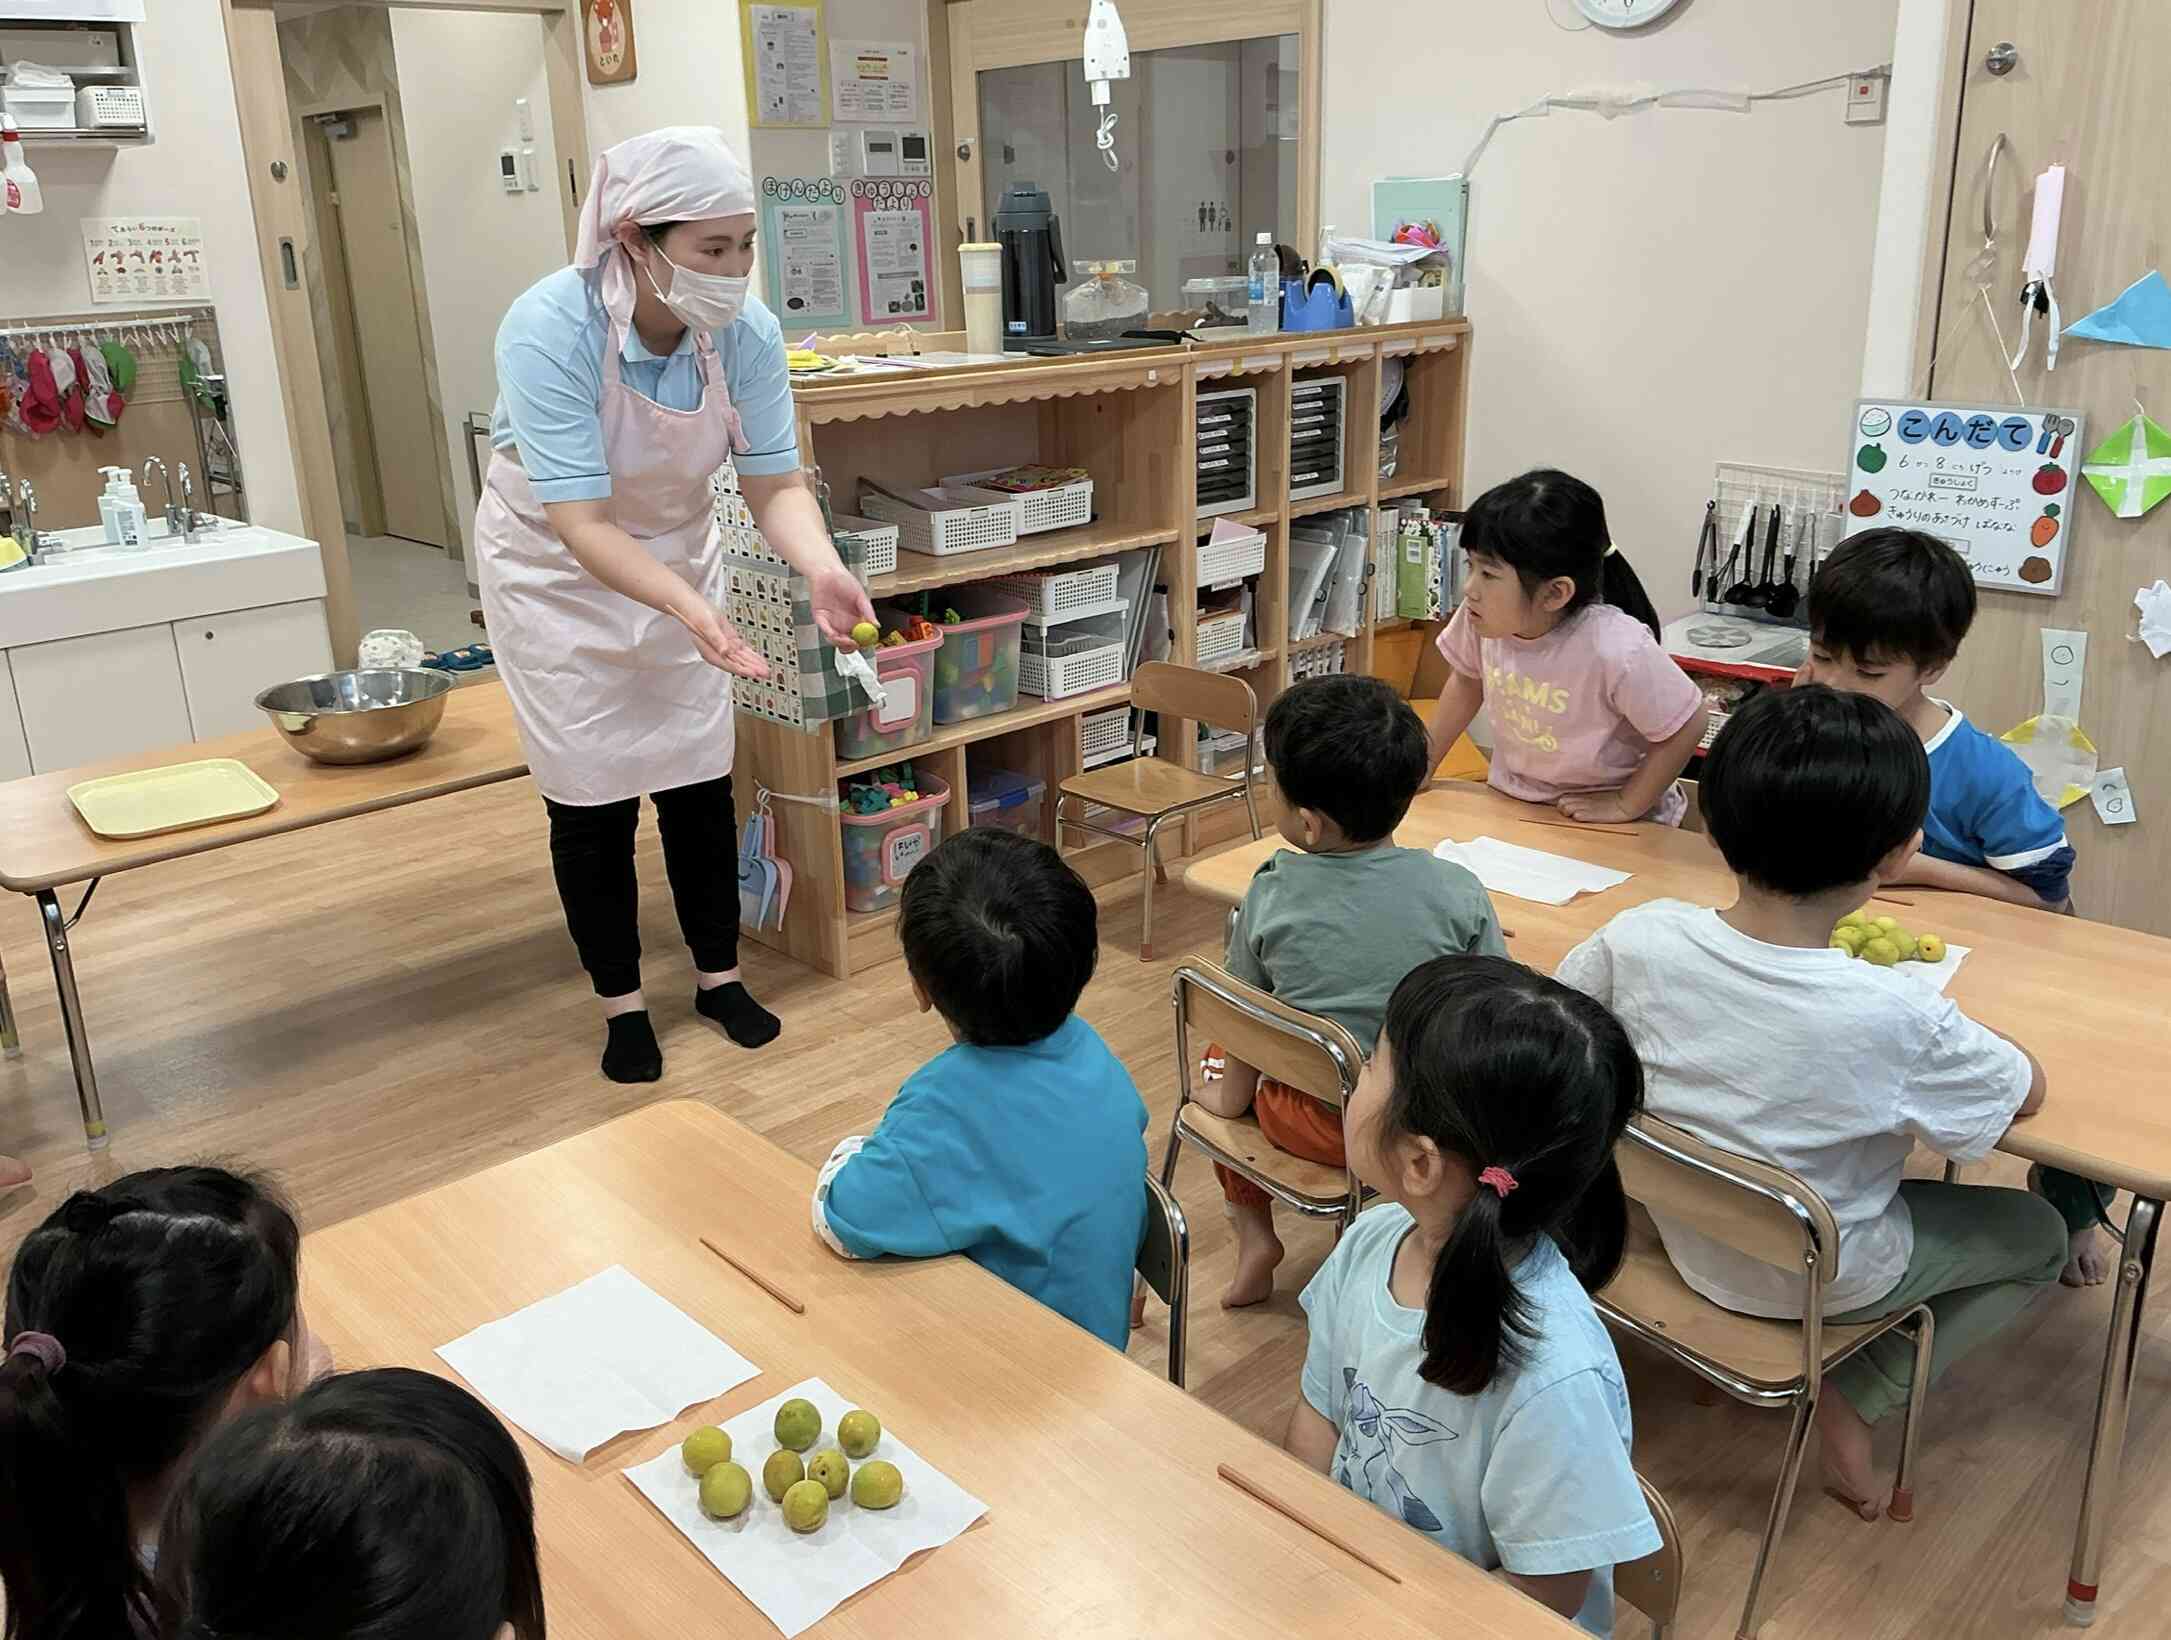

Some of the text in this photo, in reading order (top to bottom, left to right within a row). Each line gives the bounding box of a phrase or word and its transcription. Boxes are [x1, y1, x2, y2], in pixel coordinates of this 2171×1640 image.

[1903, 415, 2029, 446] こんだて
[1899, 454, 1909, 468] 6
[1935, 456, 1946, 469] 8
[1969, 460, 1992, 475] げつ
[1932, 476, 1975, 488] きゅうしょく
[1955, 494, 2021, 510] わかめすーぷ
[1975, 518, 2016, 532] ばなな
